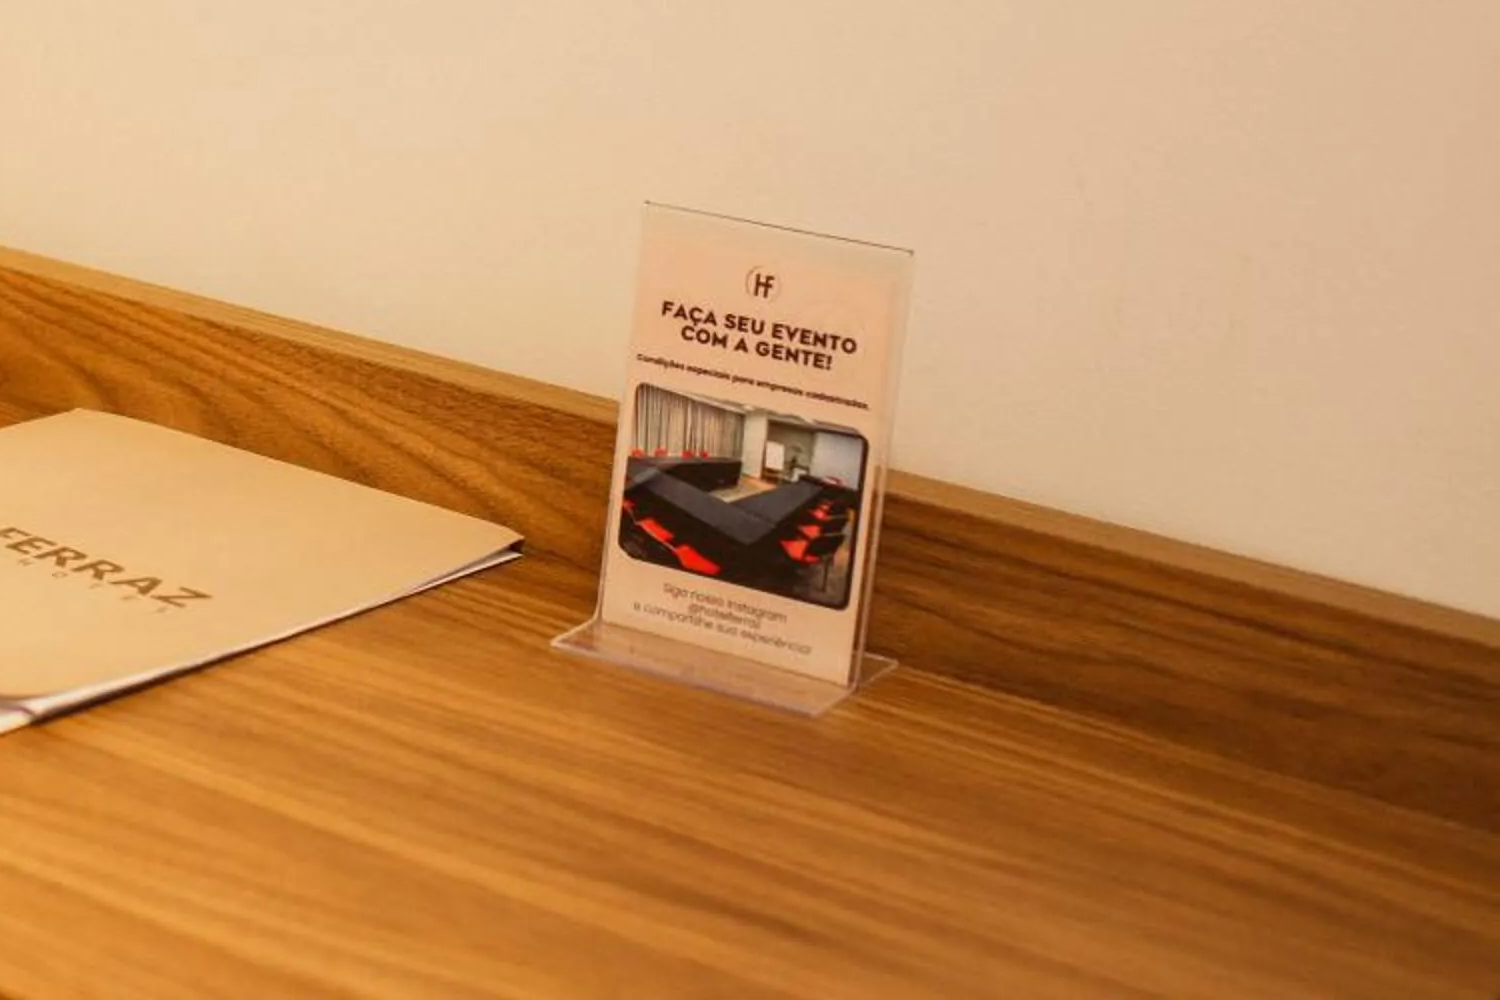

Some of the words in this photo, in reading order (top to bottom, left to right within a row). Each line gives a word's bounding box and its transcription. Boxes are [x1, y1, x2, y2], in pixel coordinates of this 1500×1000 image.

[660, 299, 718, 327] FAÇA
[723, 312, 766, 336] SEU
[770, 322, 858, 355] EVENTO
[680, 324, 729, 349] COM
[733, 336, 750, 354] A
[754, 340, 834, 371] GENTE!
[731, 374, 755, 387] para
[756, 380, 804, 397] empresas
[663, 582, 688, 600] Siga
